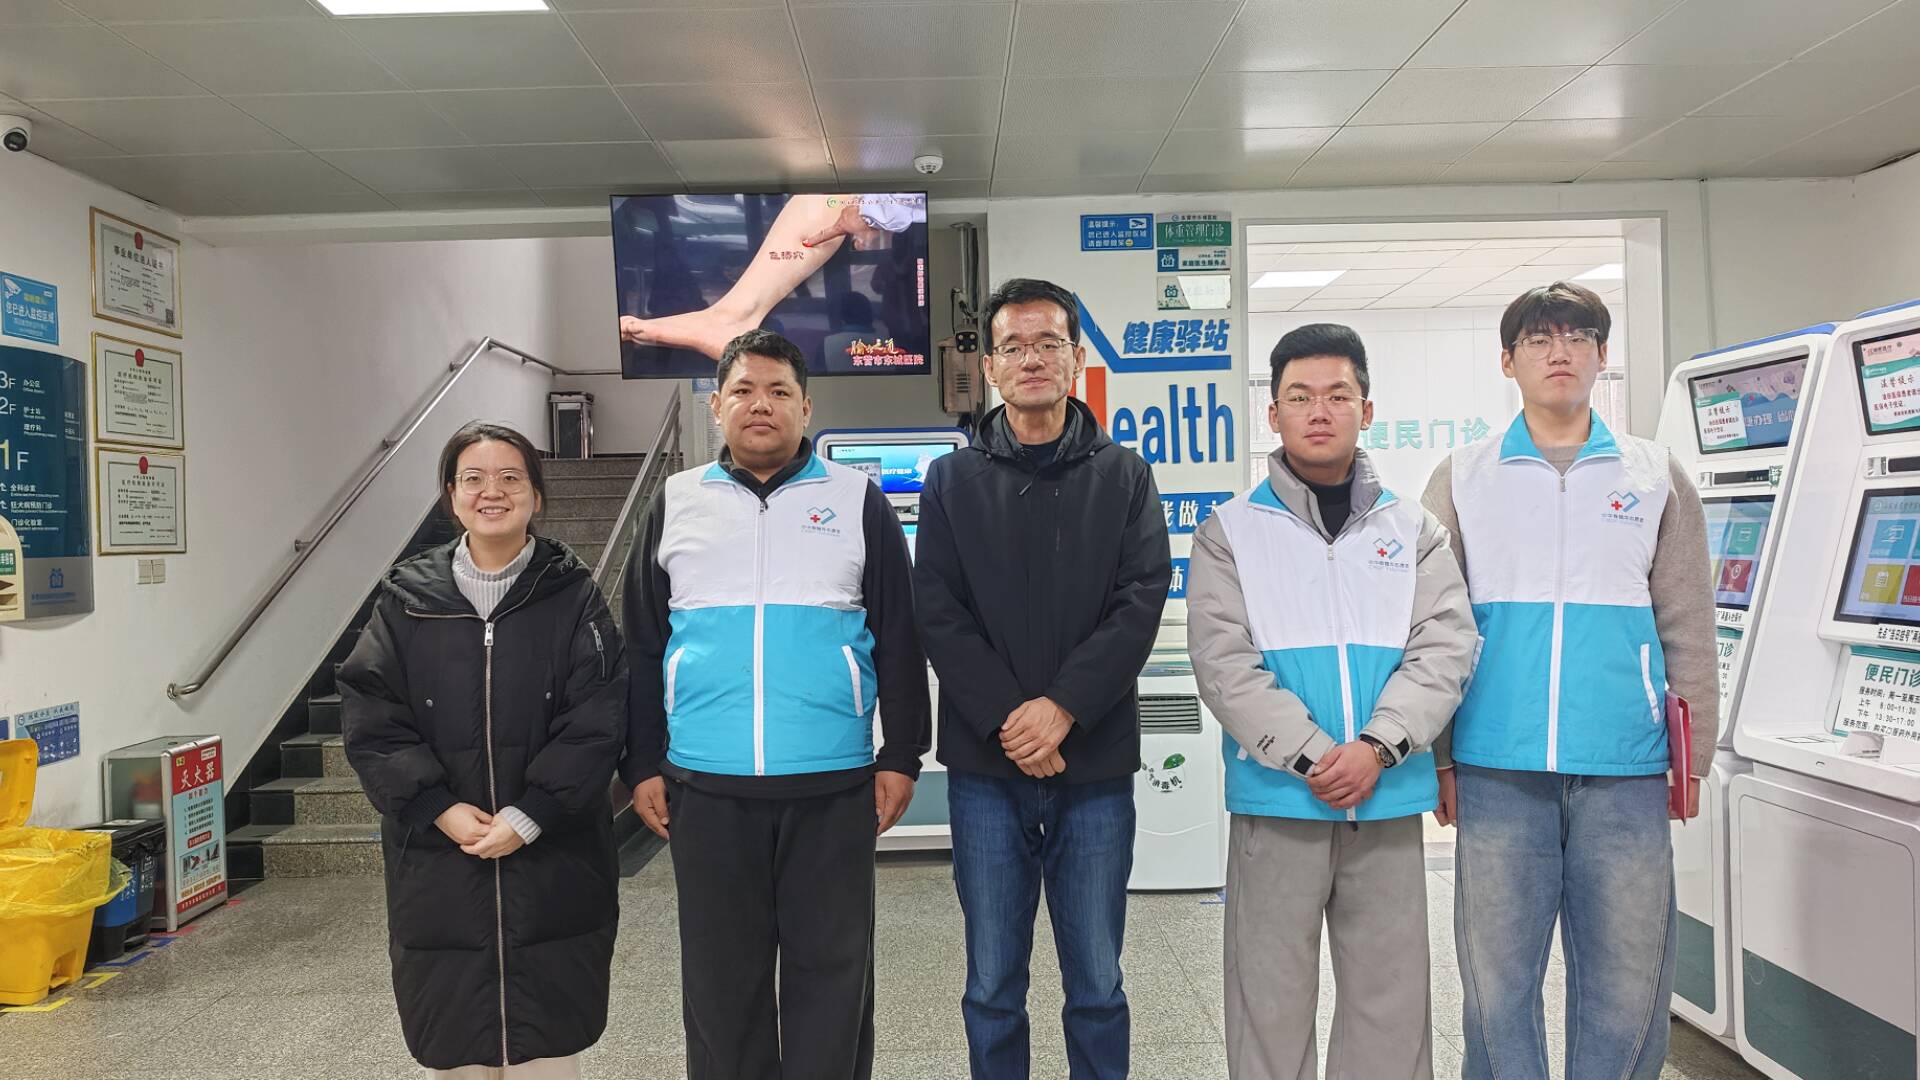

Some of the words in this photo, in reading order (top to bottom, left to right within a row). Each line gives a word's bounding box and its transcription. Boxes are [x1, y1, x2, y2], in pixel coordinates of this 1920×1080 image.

[1122, 319, 1230, 355] 健康驿站
[1360, 416, 1492, 450] 便民门诊
[1865, 663, 1920, 688] 便民门诊
[1857, 708, 1870, 717] 下午
[1858, 698, 1871, 707] 上午
[180, 760, 215, 790] 灭火器
